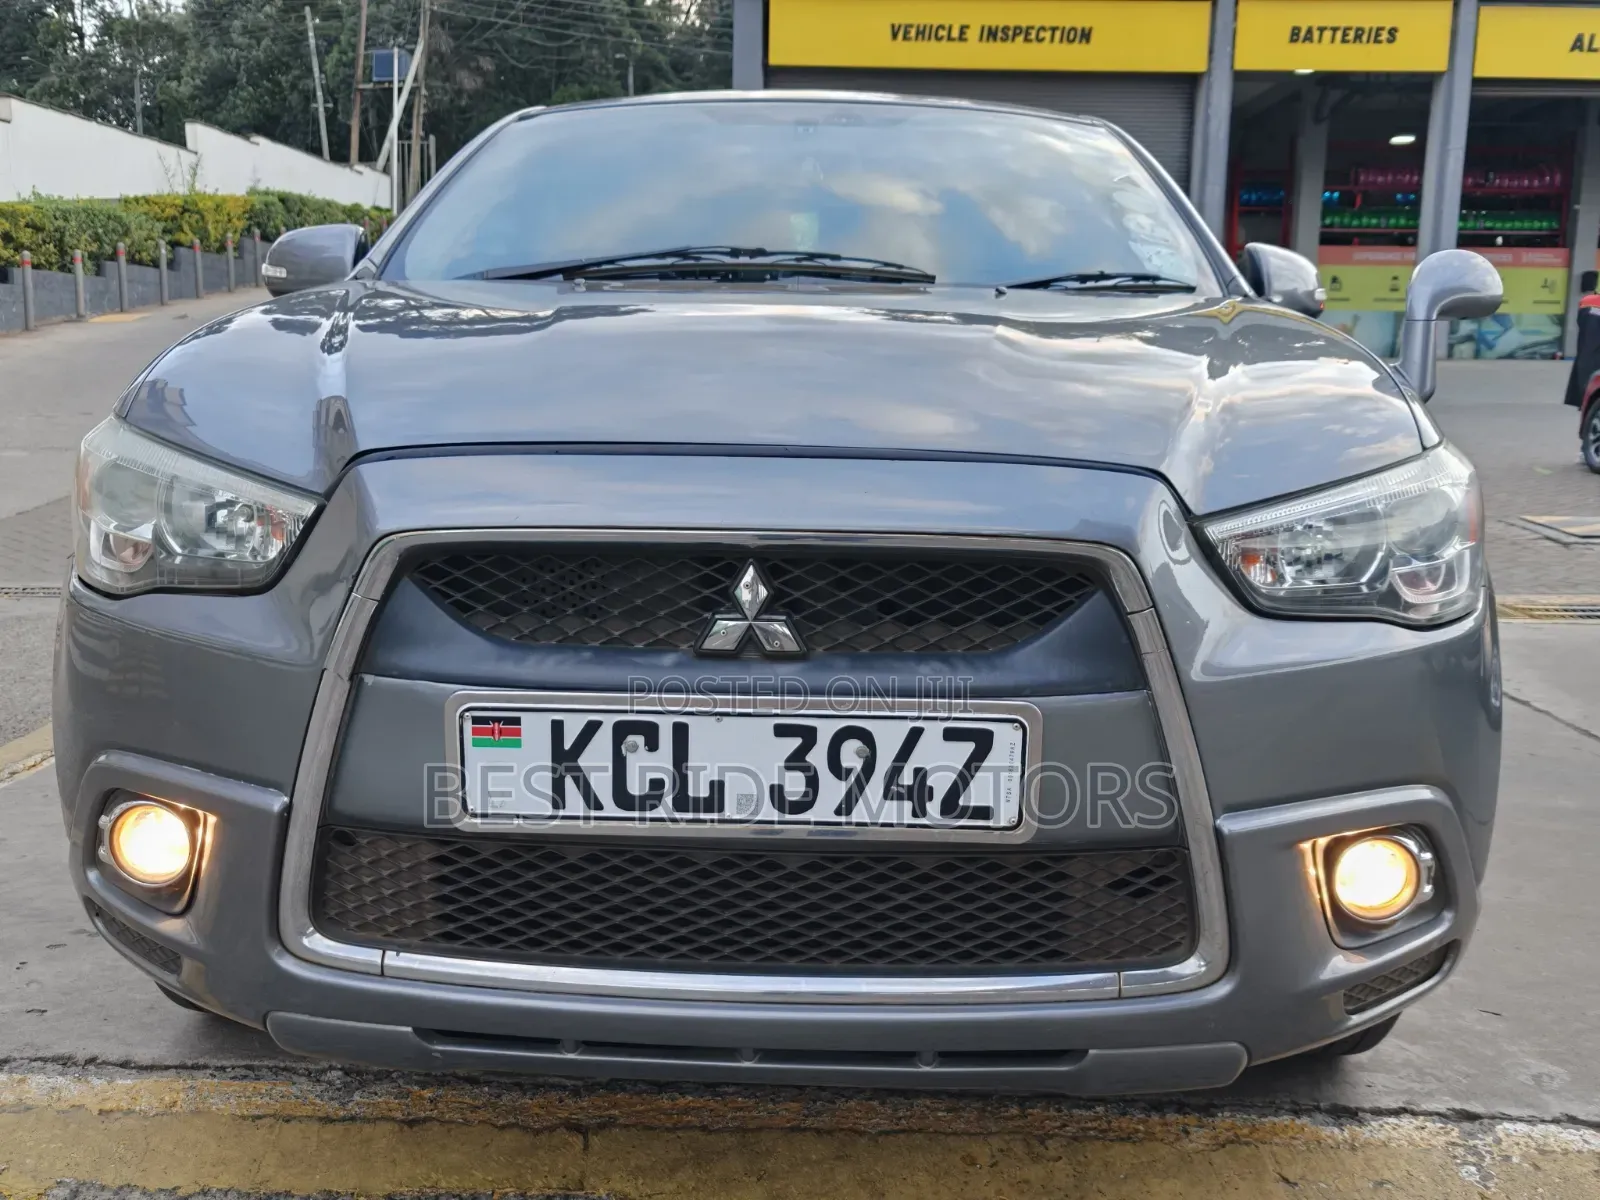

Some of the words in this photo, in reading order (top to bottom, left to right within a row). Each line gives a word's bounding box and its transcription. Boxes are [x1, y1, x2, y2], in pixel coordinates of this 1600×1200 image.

[890, 23, 970, 43] VEHICLE
[978, 25, 1094, 45] INSPECTION
[1288, 25, 1399, 45] BATTERIES
[550, 718, 725, 813] KCL
[769, 722, 995, 821] 394Z
